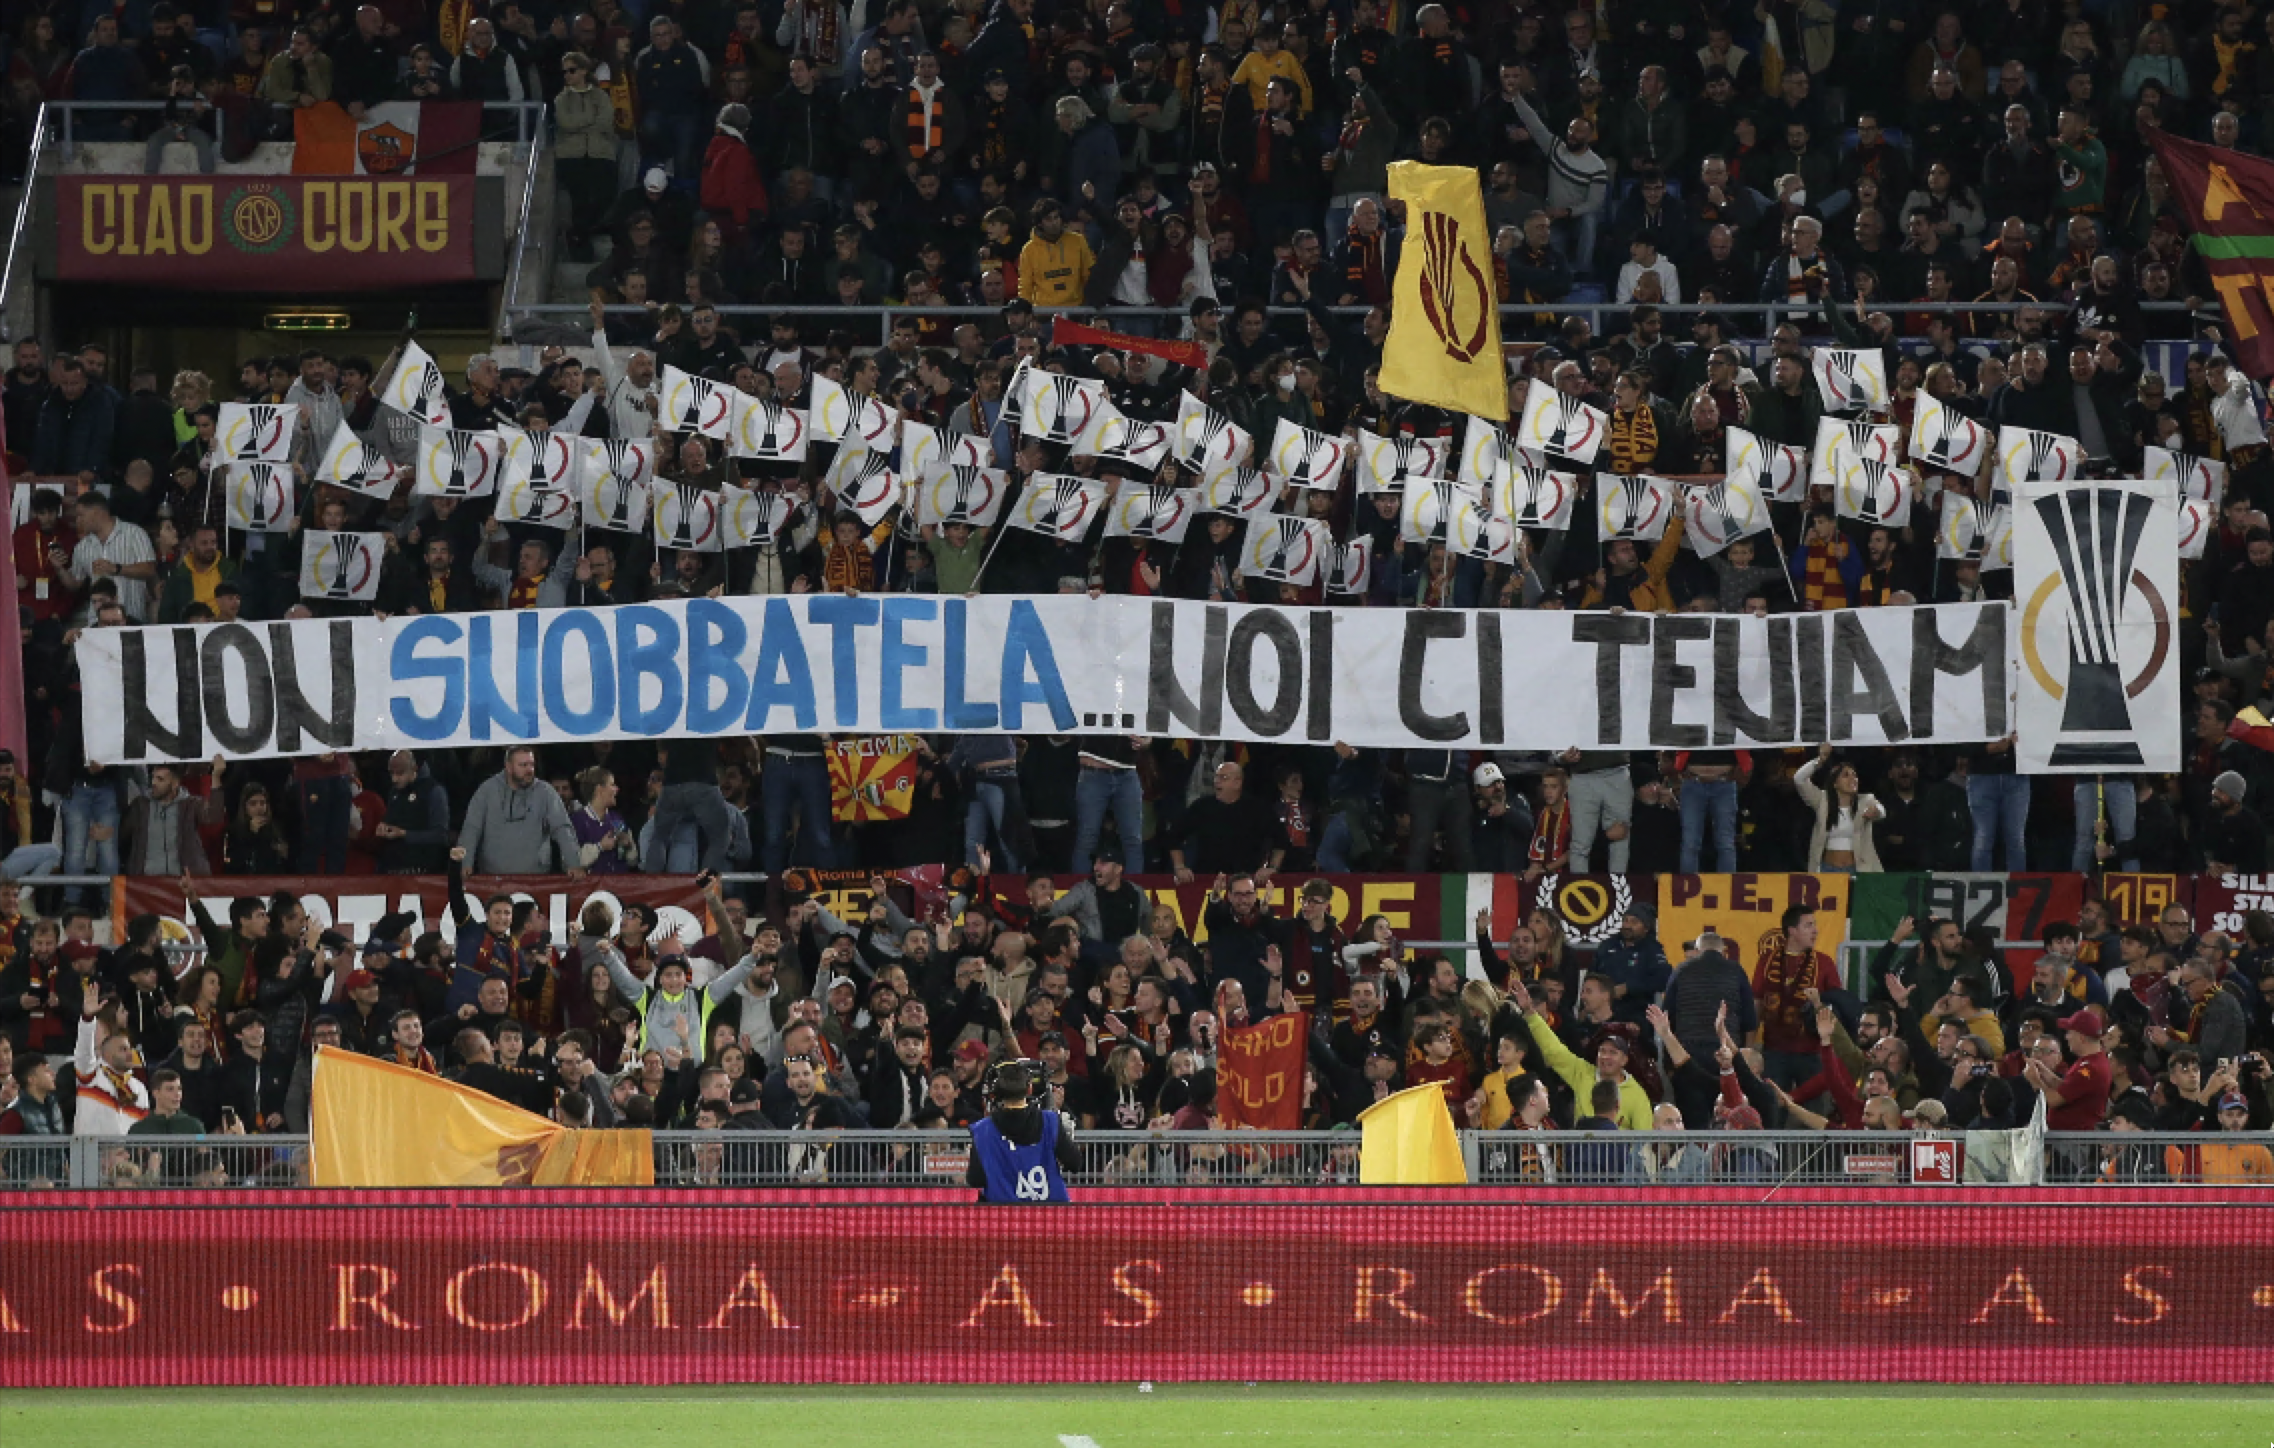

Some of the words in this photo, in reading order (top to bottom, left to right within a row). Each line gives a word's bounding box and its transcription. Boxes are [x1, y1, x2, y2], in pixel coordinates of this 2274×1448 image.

[82, 184, 214, 255] CIAO
[303, 182, 449, 253] CORE
[121, 617, 357, 759] NON
[1146, 602, 1334, 741] NOI
[1397, 609, 1506, 745] CI
[1572, 602, 2009, 747] TENIAM
[837, 735, 912, 757] ROMA
[1671, 873, 1837, 912] P.E.R.
[1905, 877, 2052, 943] 1927
[2111, 882, 2164, 923] 19
[1015, 1165, 1050, 1200] 49
[328, 1261, 800, 1332] ROMA
[1350, 1264, 1803, 1327] ROMA
